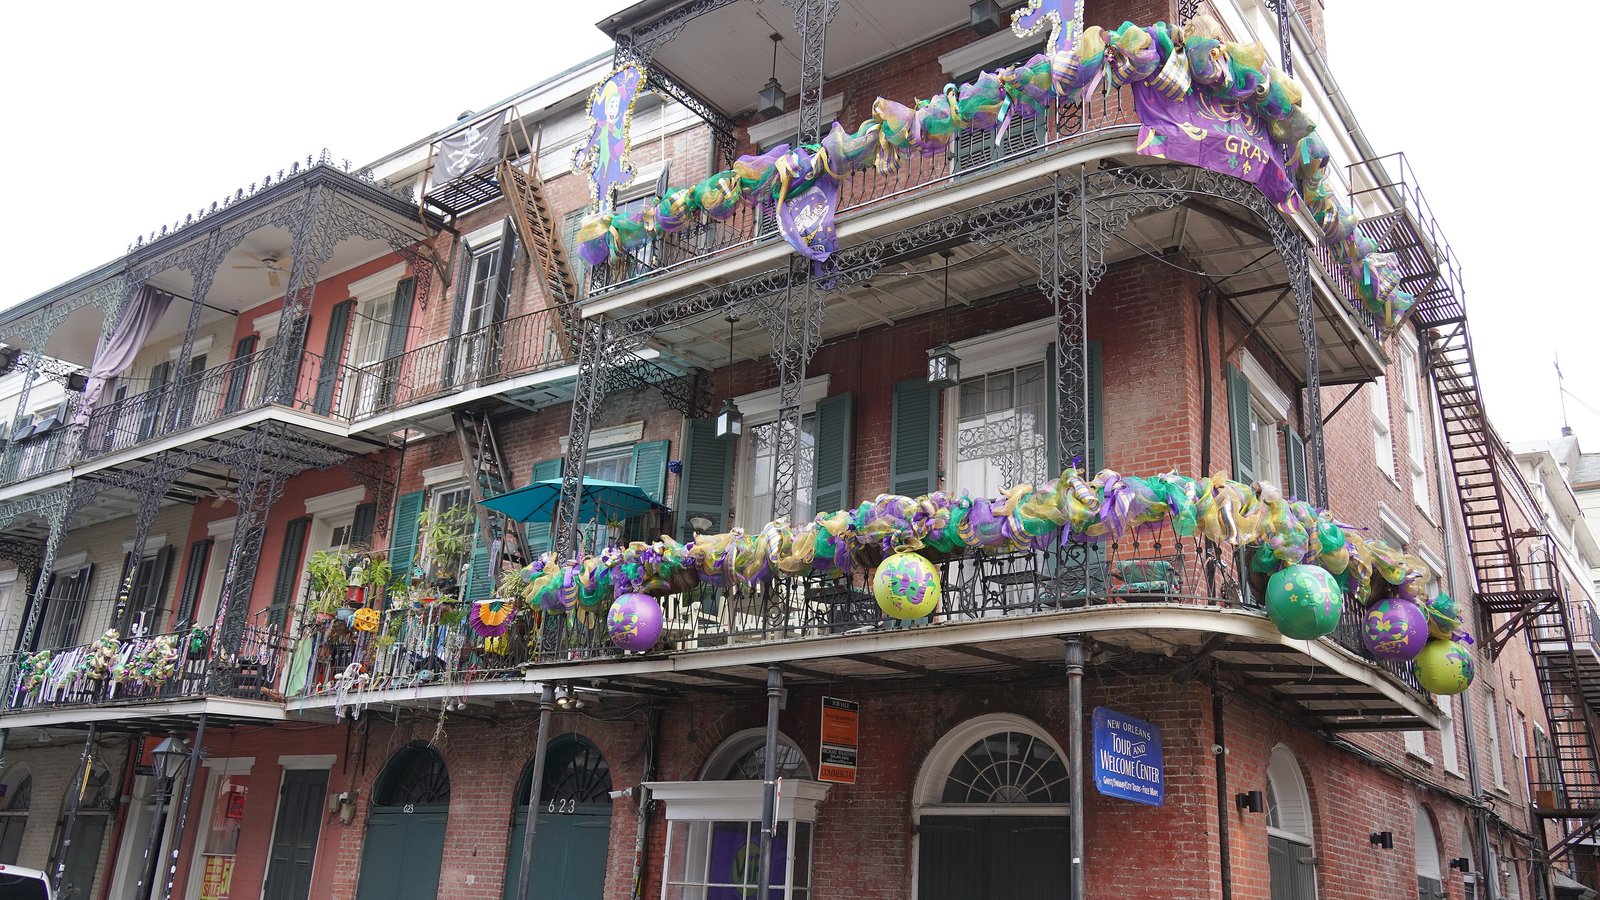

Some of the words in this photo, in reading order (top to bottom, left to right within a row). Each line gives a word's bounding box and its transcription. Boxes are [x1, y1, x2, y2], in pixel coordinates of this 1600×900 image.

[1107, 719, 1120, 730] NEW
[1122, 722, 1151, 741] ORLEANS
[1132, 743, 1146, 755] AND
[1100, 748, 1135, 778] WELCOME
[1135, 760, 1160, 784] CENTER
[403, 803, 415, 814] 623
[548, 798, 576, 814] 623
